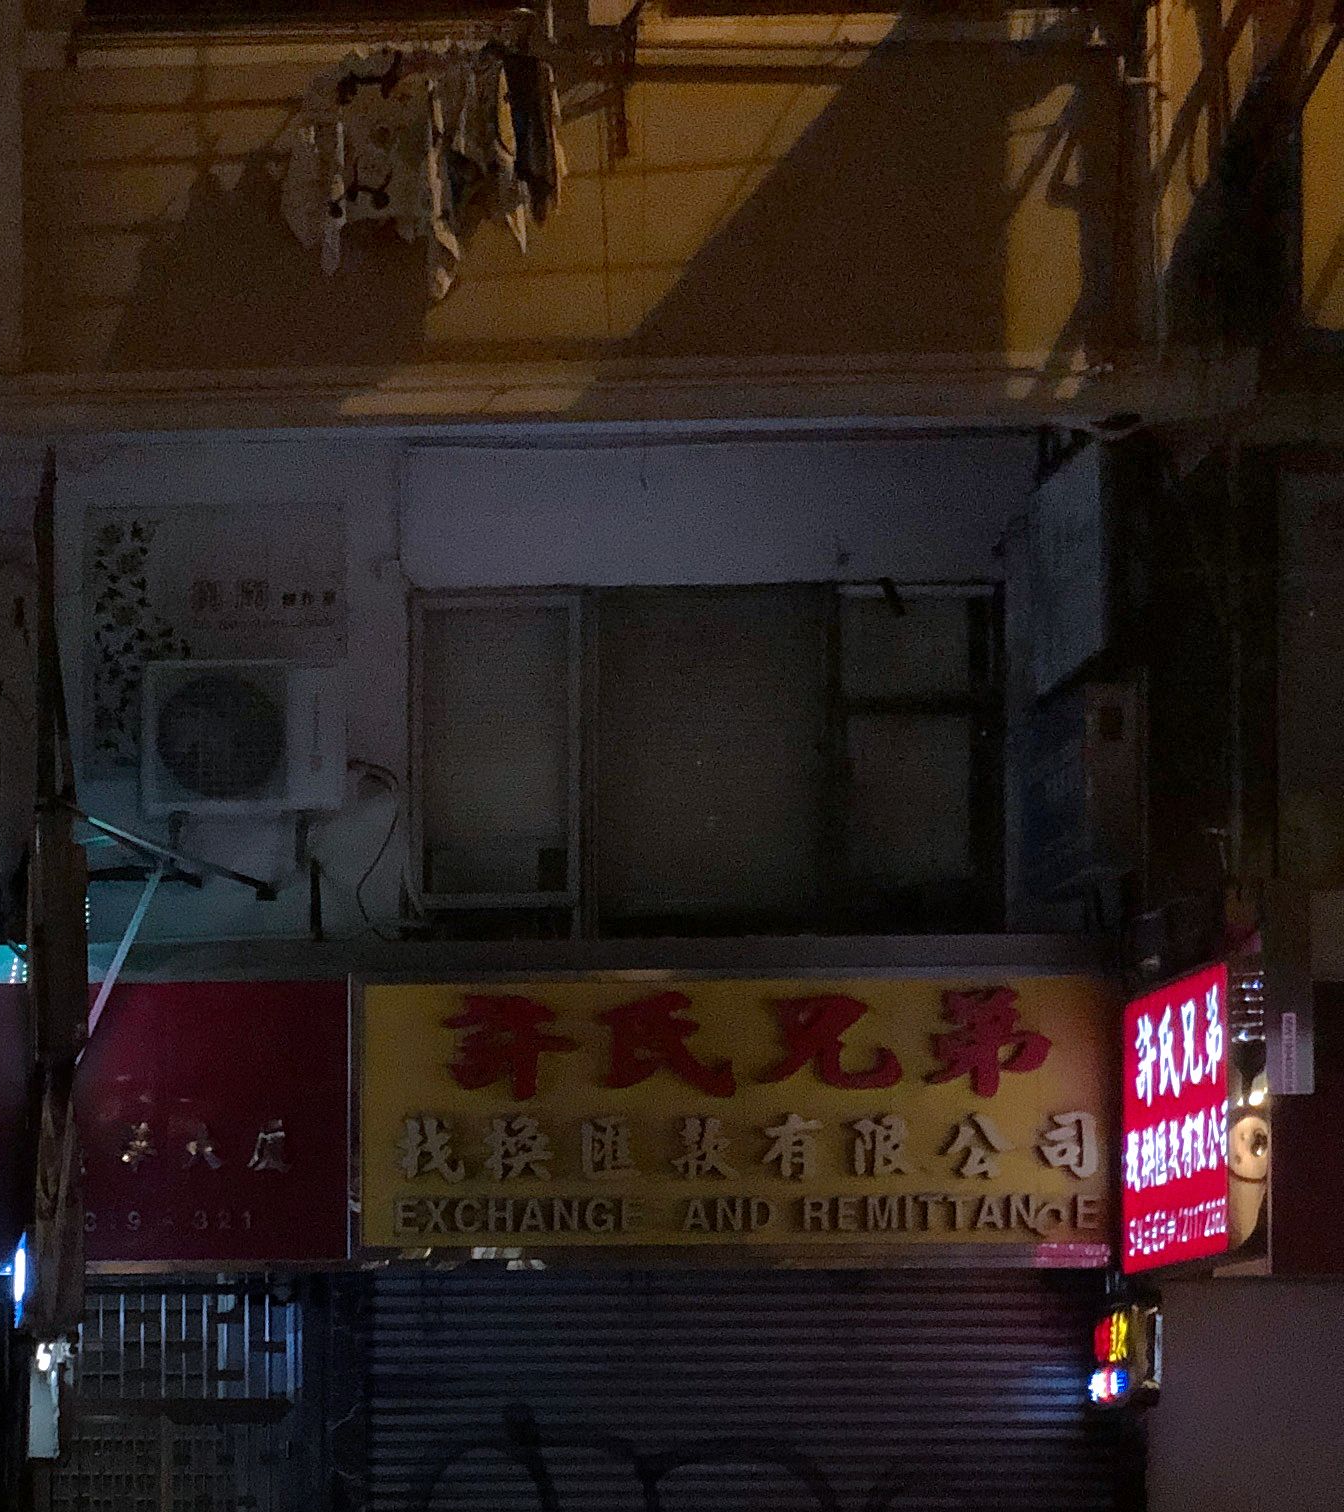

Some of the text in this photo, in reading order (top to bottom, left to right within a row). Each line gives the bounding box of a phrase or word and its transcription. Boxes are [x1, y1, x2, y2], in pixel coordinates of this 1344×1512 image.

[398, 1111, 1100, 1181] 找換匯款有限公司
[394, 1198, 644, 1235] EXCHANGE
[682, 1198, 775, 1235] AND
